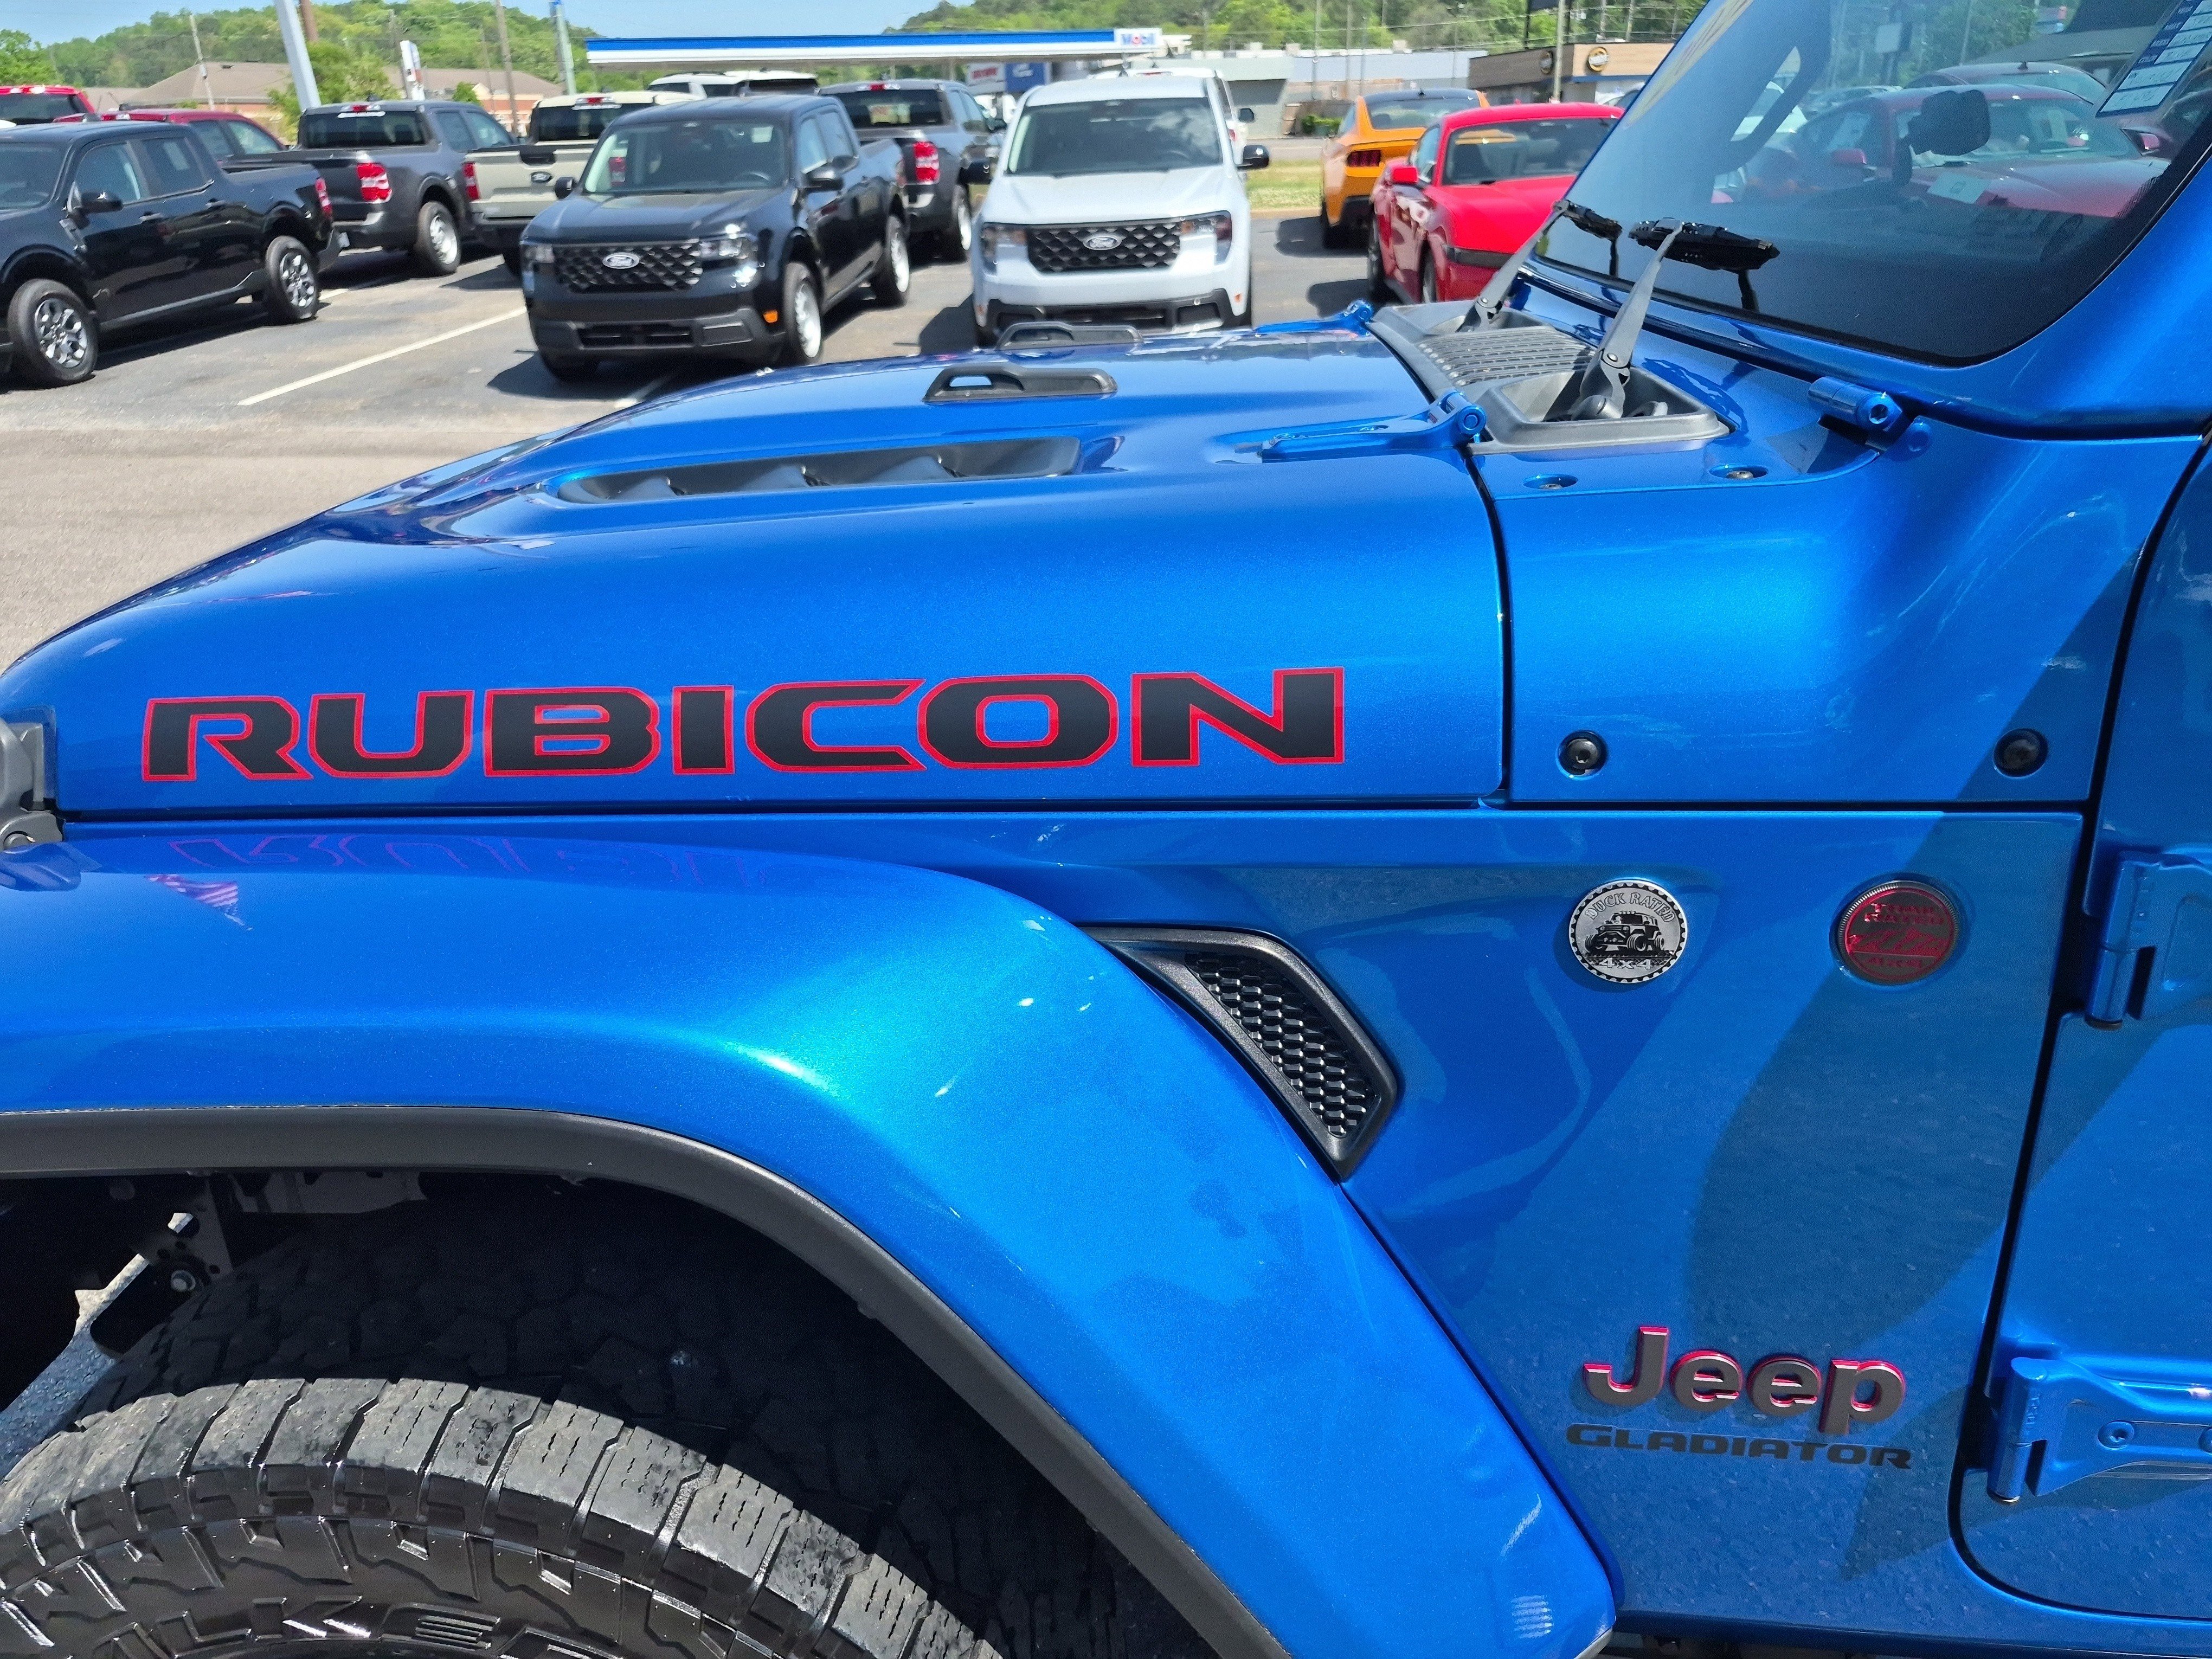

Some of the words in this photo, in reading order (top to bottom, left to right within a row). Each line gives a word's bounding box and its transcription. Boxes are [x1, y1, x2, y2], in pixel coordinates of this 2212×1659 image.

[141, 666, 1345, 782] RUBICON
[1584, 892, 1626, 921] DUCK
[1629, 892, 1675, 923] RATED
[1583, 1326, 1907, 1435] Jeep
[1565, 1422, 1912, 1470] GLADIATOR
